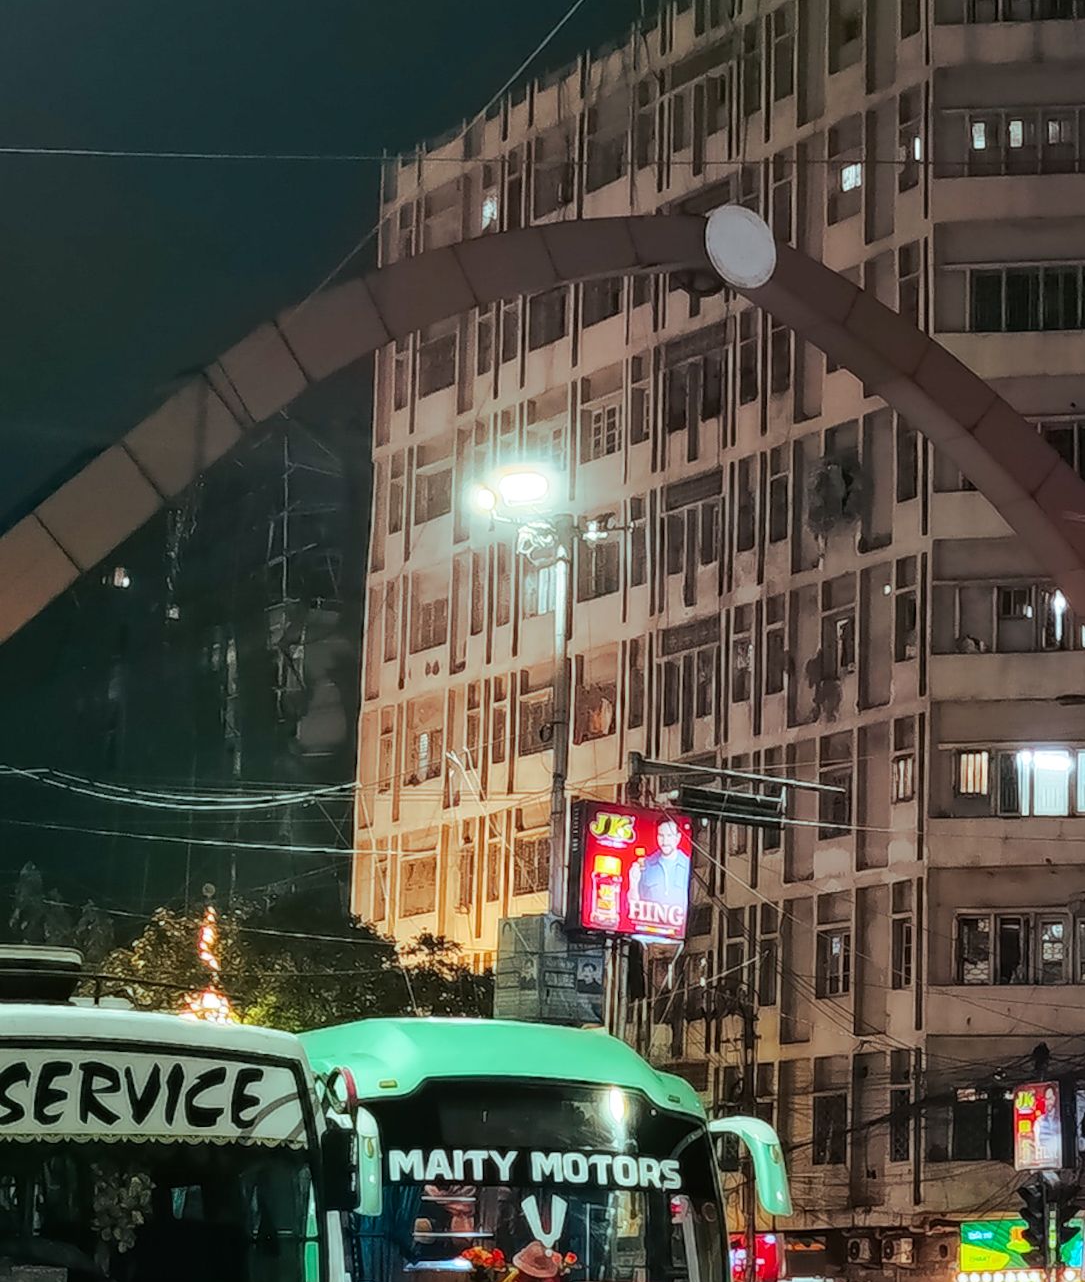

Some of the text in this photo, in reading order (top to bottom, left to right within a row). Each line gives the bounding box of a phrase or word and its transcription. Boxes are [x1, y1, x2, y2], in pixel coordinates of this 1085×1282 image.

[628, 899, 684, 925] HING
[0, 1061, 264, 1129] SERVICE
[388, 1149, 682, 1190] MAITY MOTORS
